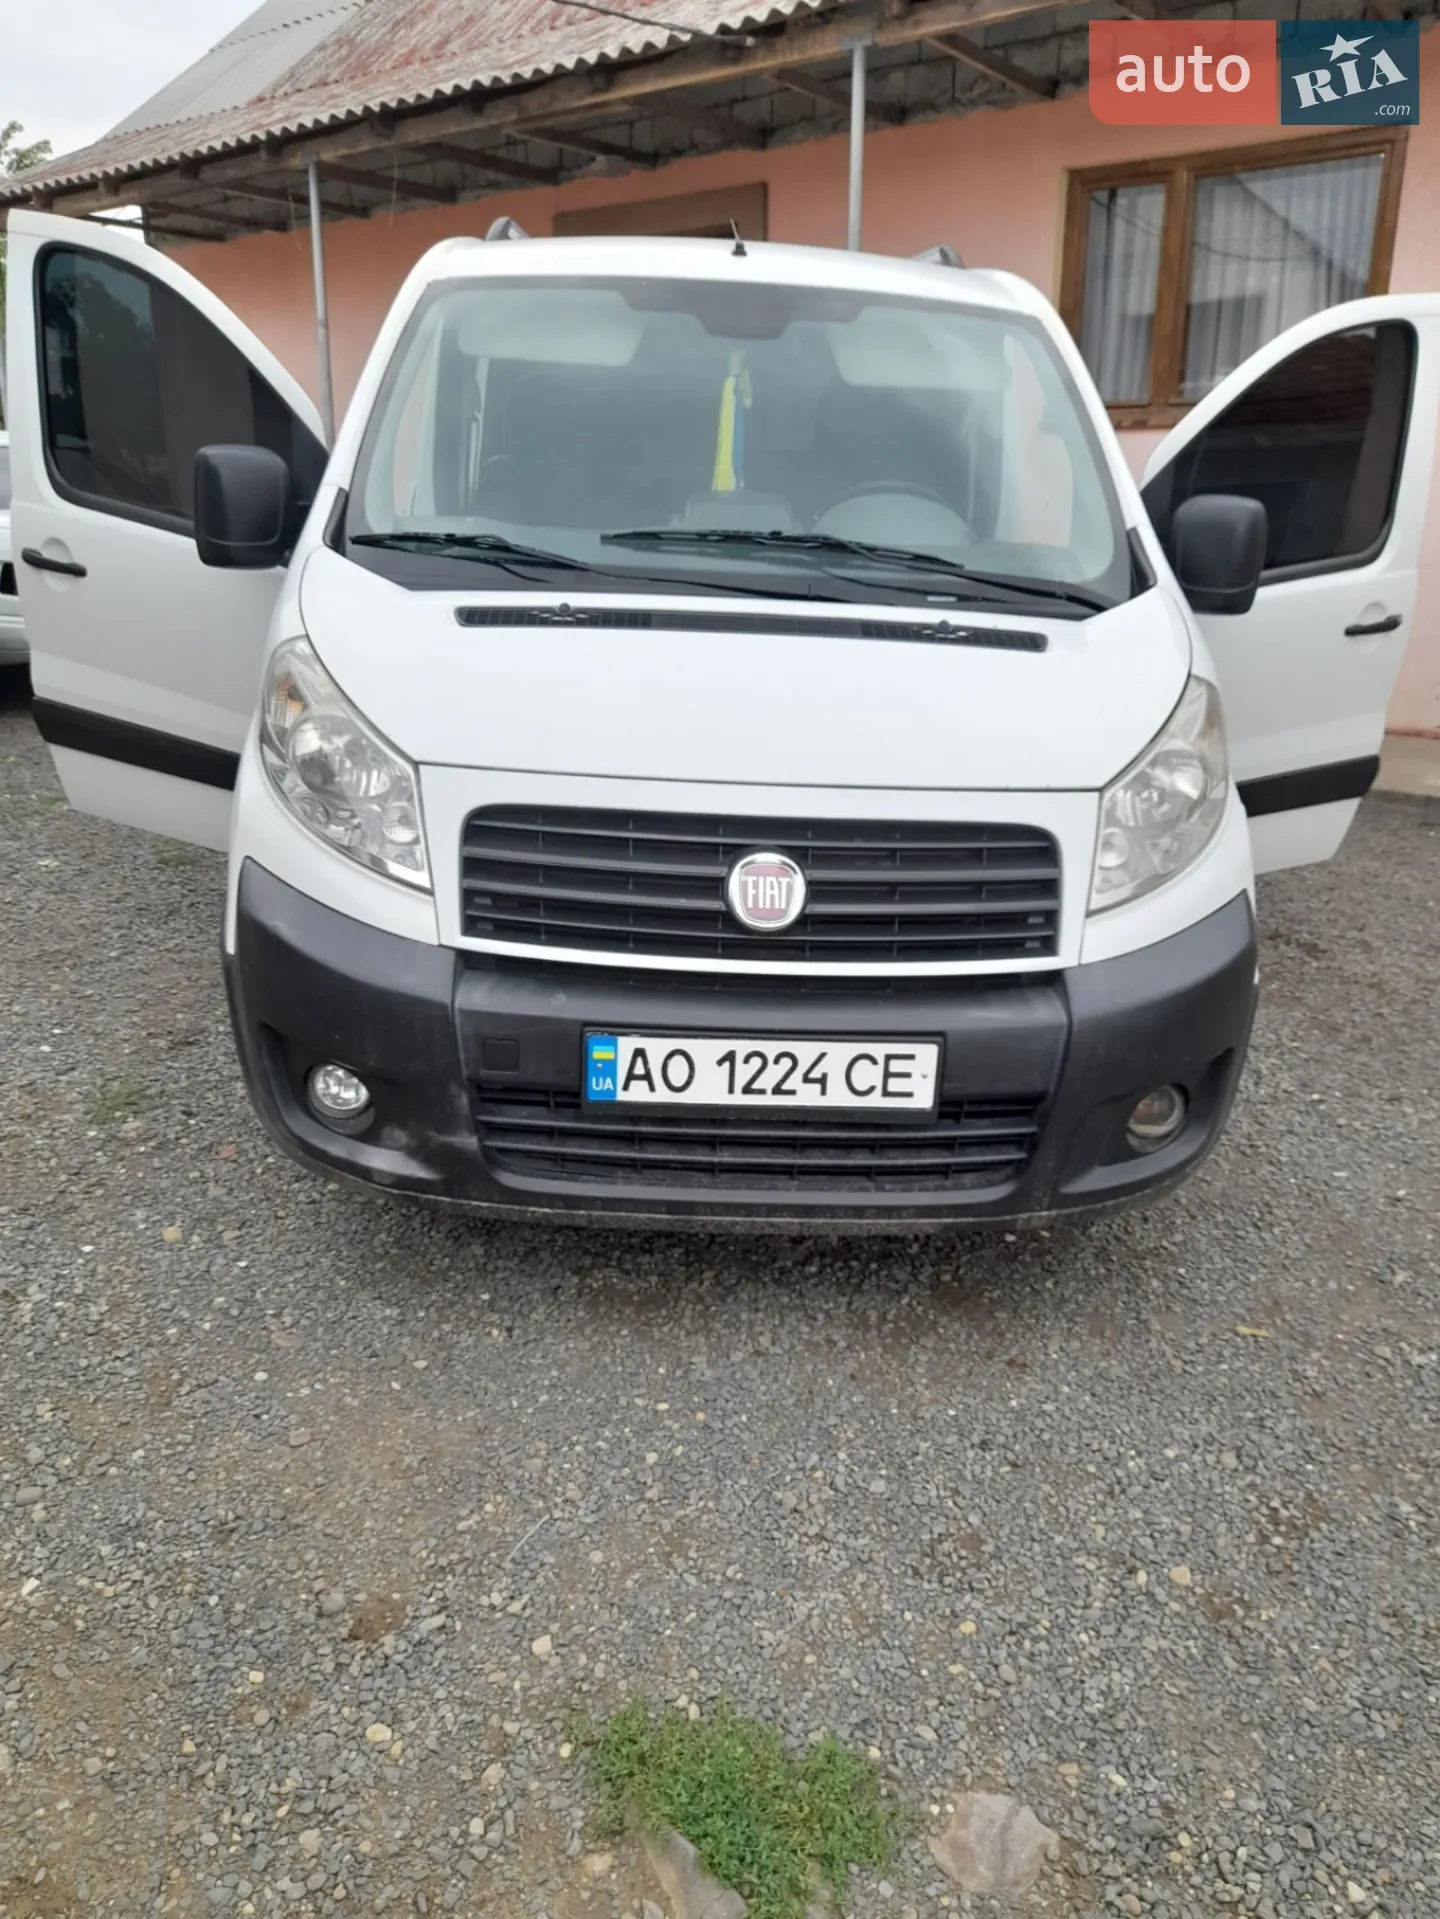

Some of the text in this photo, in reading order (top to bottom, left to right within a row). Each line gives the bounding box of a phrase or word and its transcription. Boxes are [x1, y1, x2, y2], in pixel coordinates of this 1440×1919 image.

[743, 875, 792, 909] FIAT
[592, 1077, 614, 1092] UA
[621, 1047, 917, 1098] AO 1224 CE
